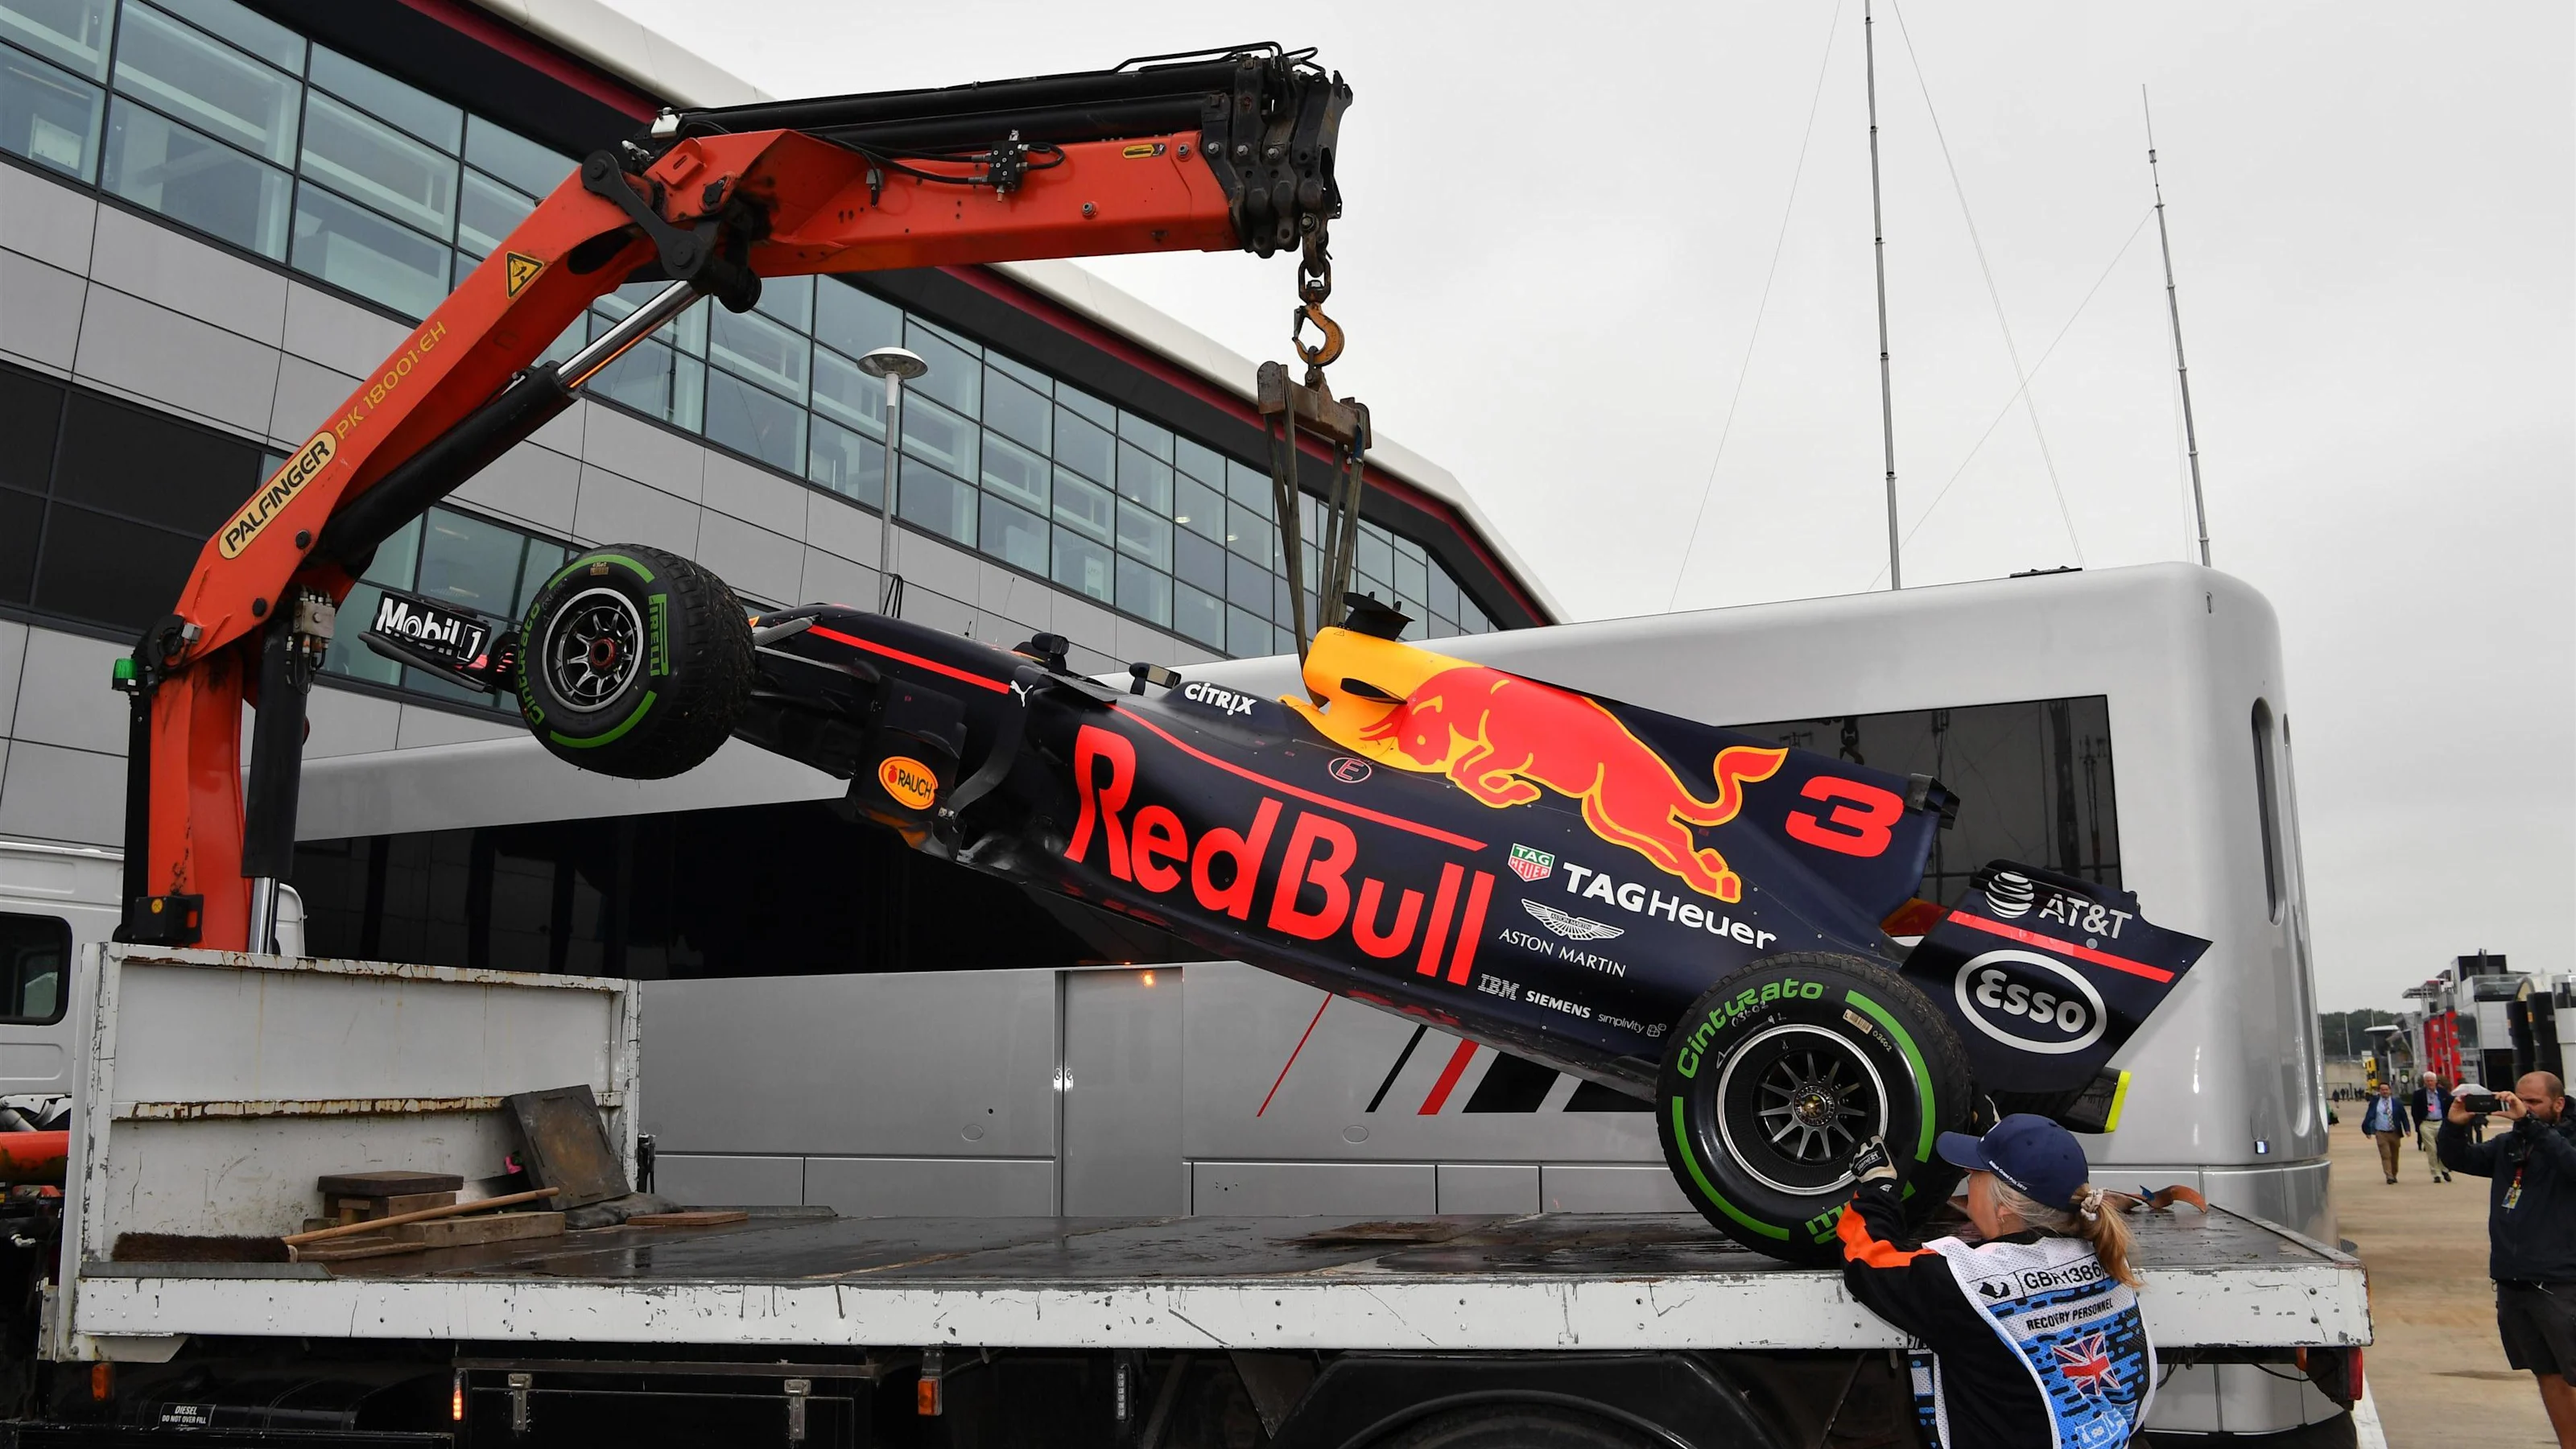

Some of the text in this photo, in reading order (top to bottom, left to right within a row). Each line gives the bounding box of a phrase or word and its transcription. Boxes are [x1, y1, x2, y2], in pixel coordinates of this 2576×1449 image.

[334, 405, 364, 440] PK
[225, 440, 331, 552] PALFINGER
[375, 597, 461, 656] Mobil
[897, 768, 933, 801] RAUCH
[1785, 774, 1905, 858] 3
[1509, 857, 1550, 879] HEUER
[1515, 846, 1550, 865] TAG
[2037, 893, 2133, 939] AT&T
[1498, 927, 1627, 978] ASTON MARTIN
[1477, 973, 1521, 1001] IBM
[1525, 990, 1591, 1018] SIEMENS
[1872, 1030, 1893, 1053] 03602
[2072, 1298, 2114, 1321] PERSONNEL
[161, 1414, 170, 1422] DO
[182, 1416, 196, 1424] OVER
[174, 1406, 198, 1415] DIESEL
